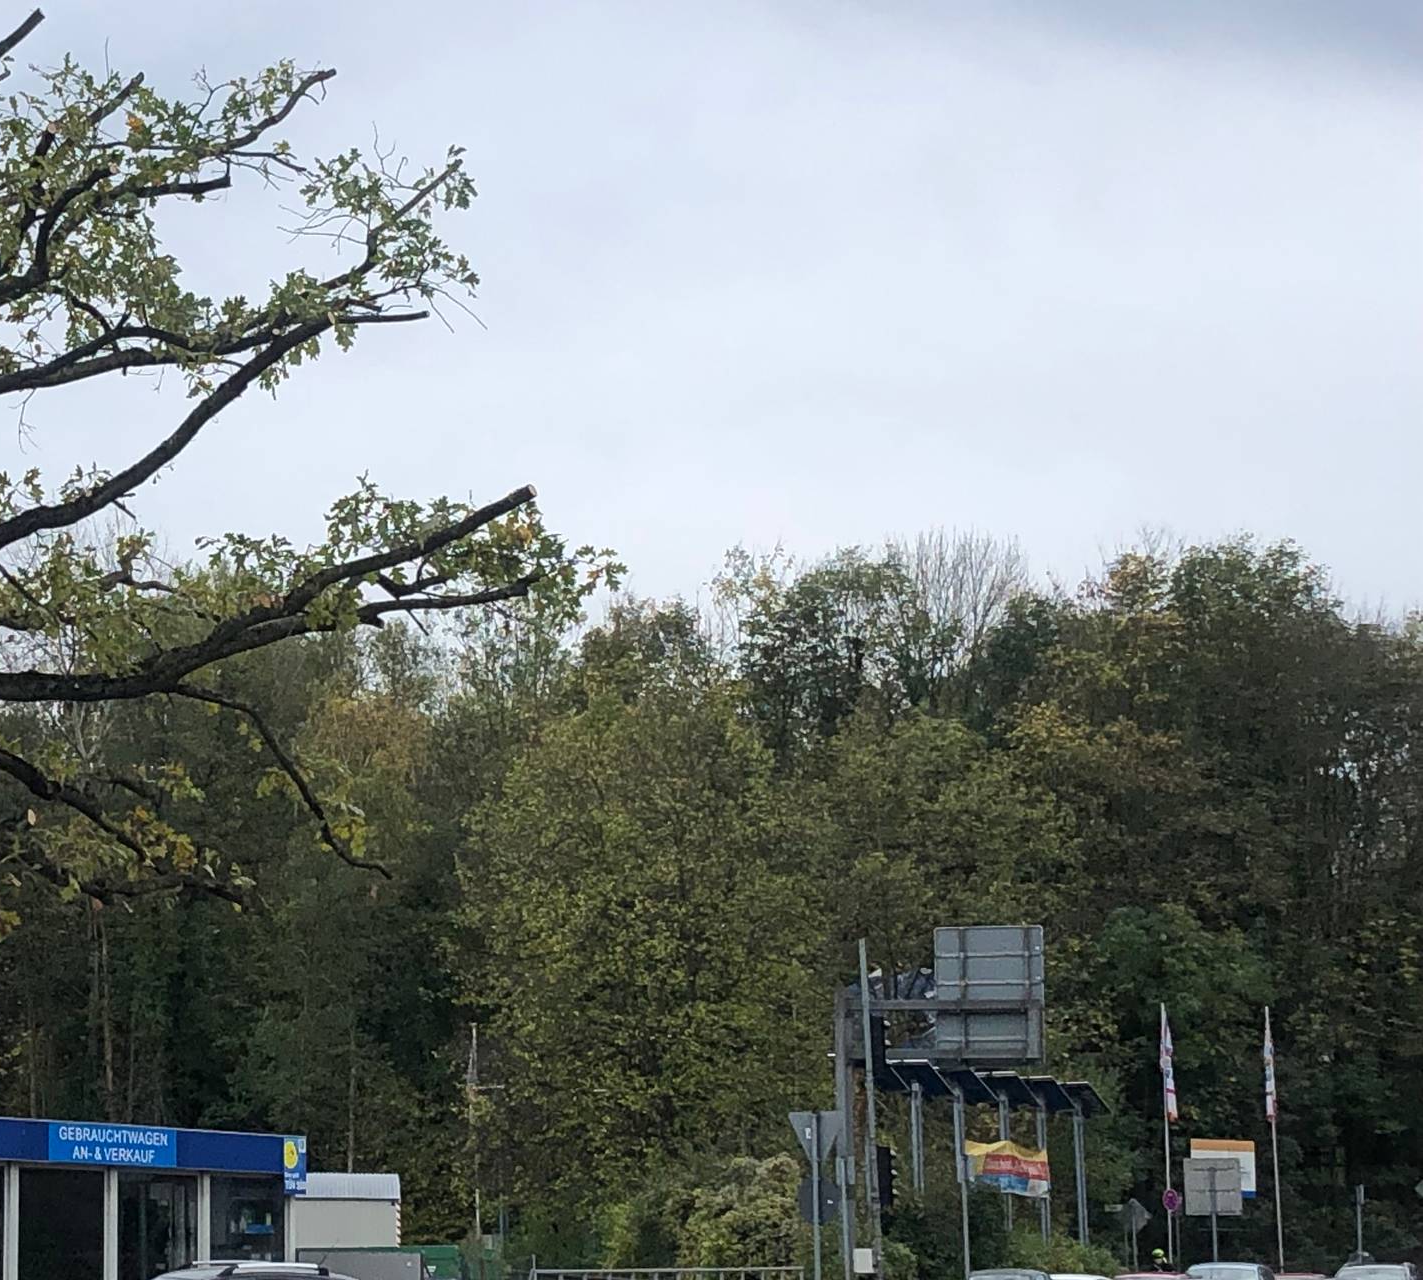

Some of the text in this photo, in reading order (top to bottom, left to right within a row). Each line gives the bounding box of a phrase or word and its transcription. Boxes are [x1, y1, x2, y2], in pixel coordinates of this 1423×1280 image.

[58, 1126, 169, 1146] GEBRAUCHTWAGEN
[72, 1145, 155, 1163] AN- & VERKAUF
